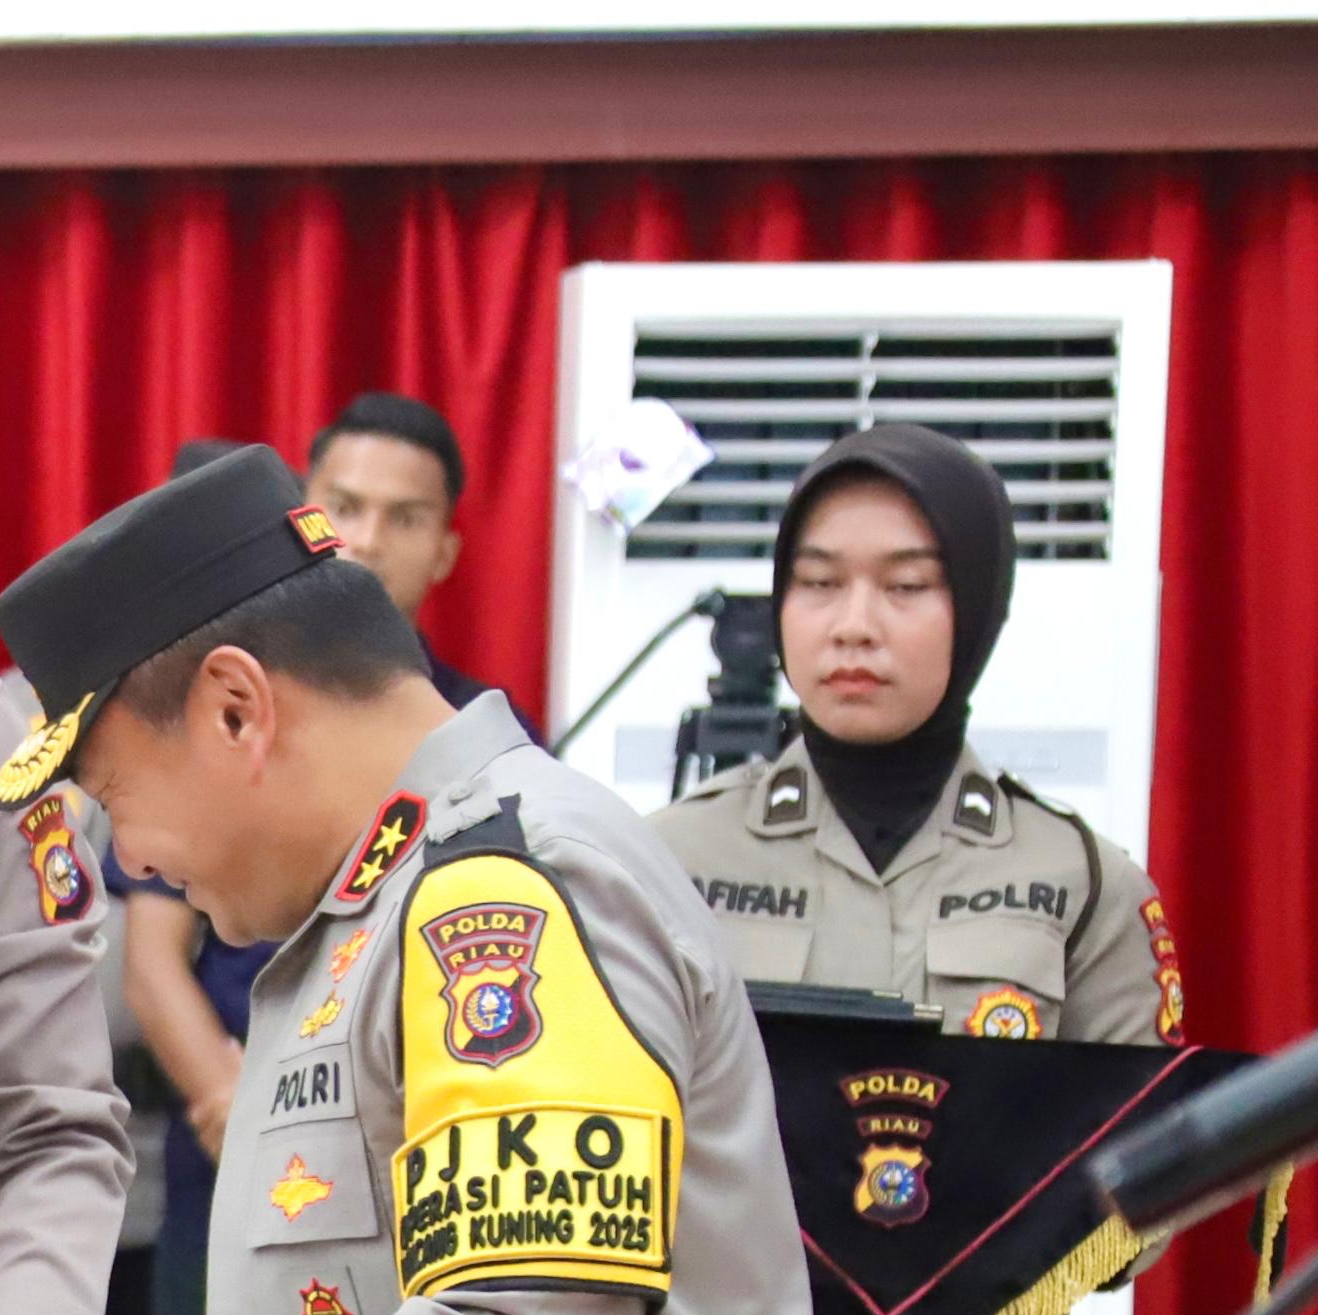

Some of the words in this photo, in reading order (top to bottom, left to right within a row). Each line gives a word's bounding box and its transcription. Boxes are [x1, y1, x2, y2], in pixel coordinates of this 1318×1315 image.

[27, 800, 61, 832] RIAU
[939, 882, 1068, 920] POLRI
[439, 913, 525, 943] POLDA
[449, 943, 524, 968] RIAU
[270, 1061, 341, 1116] POLRI
[850, 1074, 935, 1102] POLDA
[871, 1118, 919, 1135] RIAU
[524, 1169, 651, 1213] PATUH
[469, 1208, 574, 1251] KUNING
[588, 1211, 652, 1253] 2025
